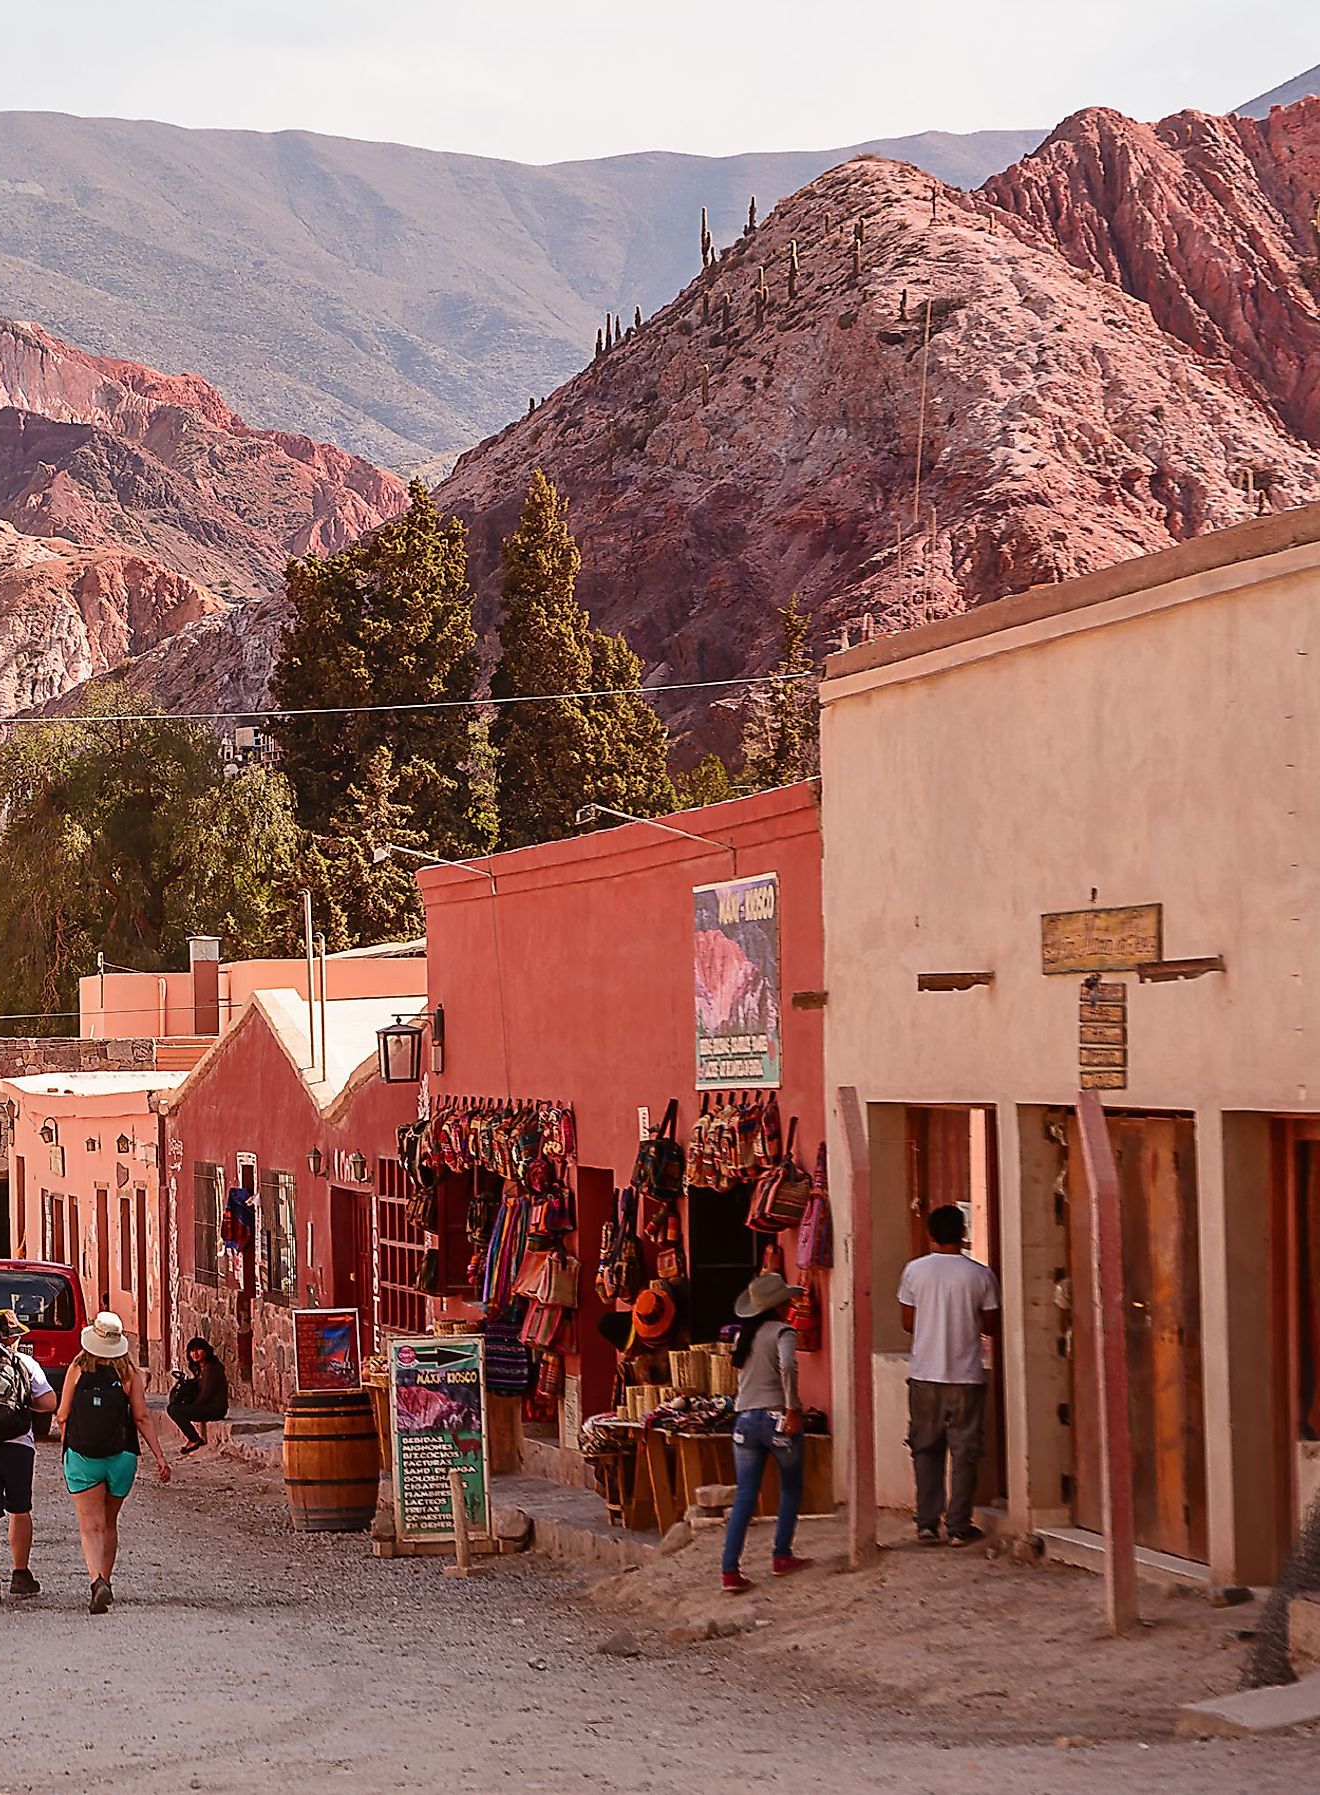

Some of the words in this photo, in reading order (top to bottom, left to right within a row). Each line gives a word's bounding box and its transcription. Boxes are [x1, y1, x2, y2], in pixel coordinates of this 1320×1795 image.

[446, 1371, 478, 1385] KIOSCO
[402, 1436, 444, 1444] BEBIDAS
[403, 1458, 453, 1467] FACTURAS
[404, 1474, 450, 1482] GOLOSIN
[405, 1497, 447, 1505] LACTEOS
